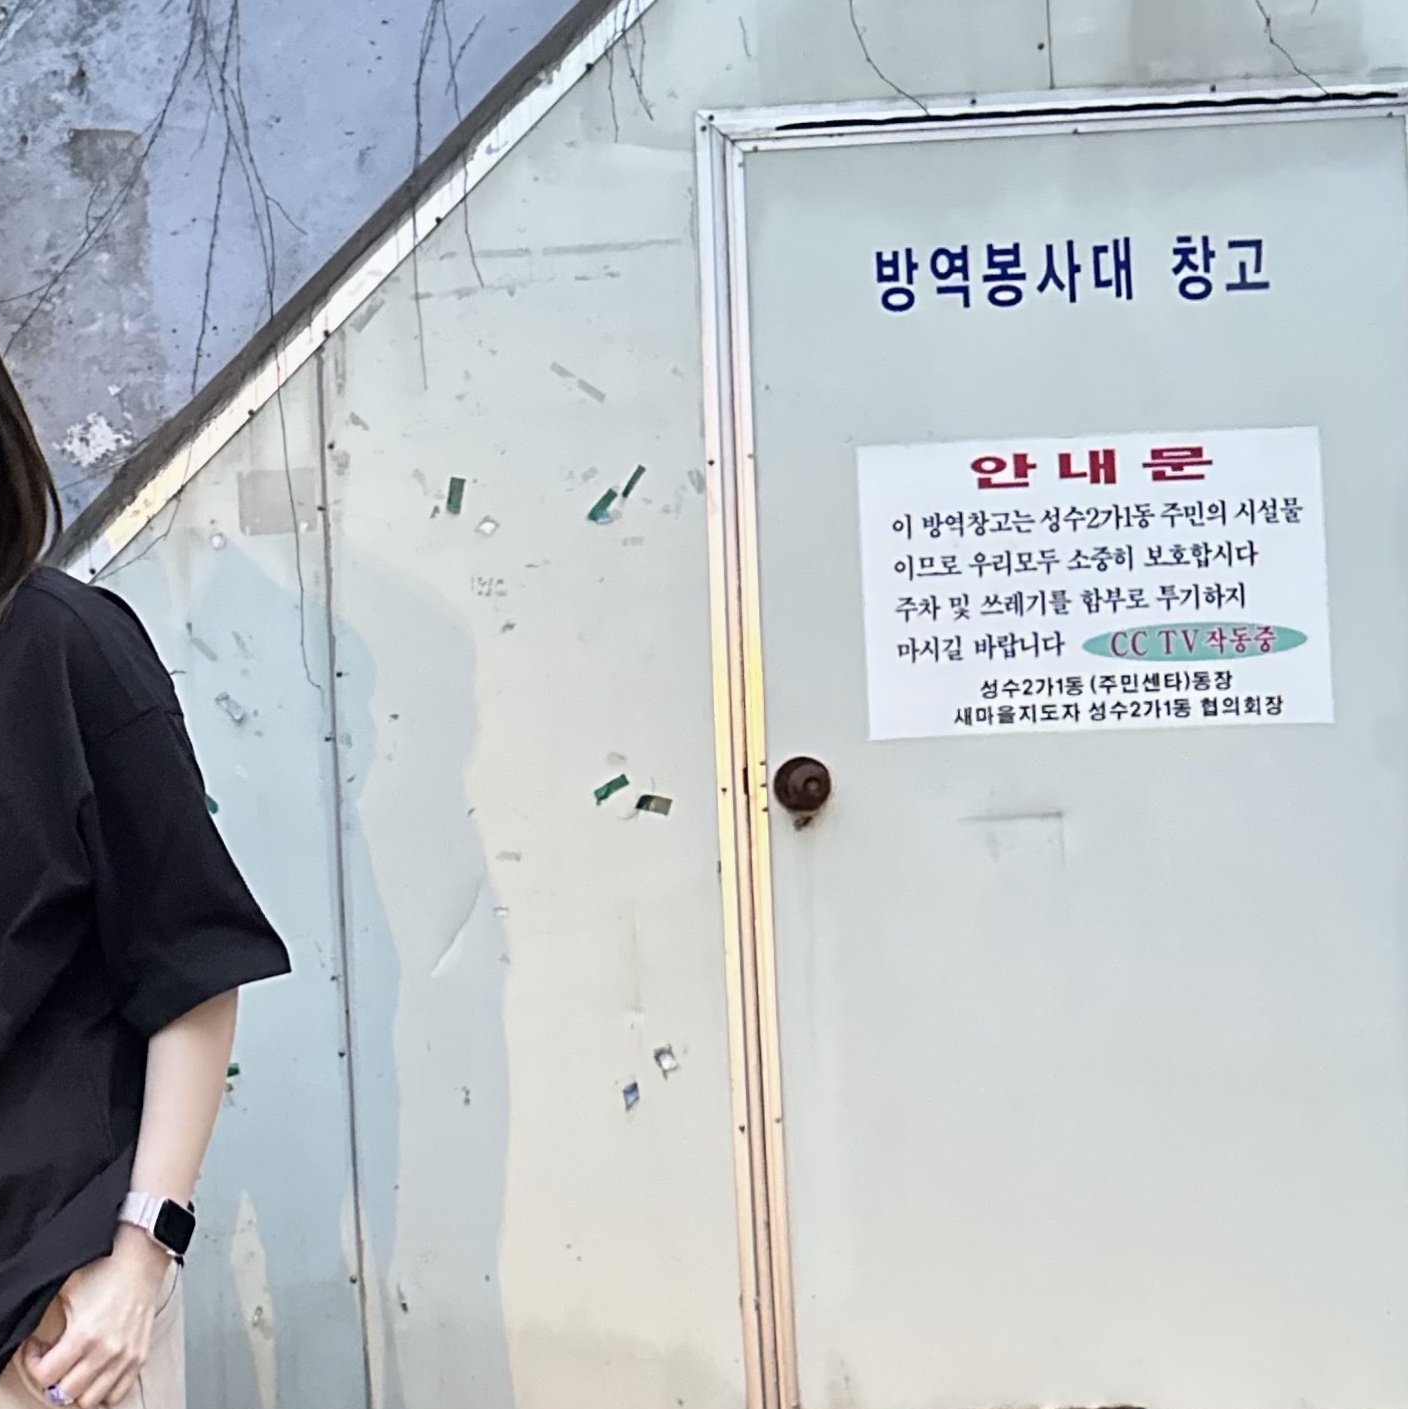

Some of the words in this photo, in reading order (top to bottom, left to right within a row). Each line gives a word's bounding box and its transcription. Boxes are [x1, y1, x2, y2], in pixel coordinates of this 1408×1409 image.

[875, 236, 1133, 313] 방역봉사대
[1171, 235, 1270, 301] 창고
[892, 513, 912, 540] 이
[922, 509, 1035, 539] 방역창고는
[1041, 502, 1156, 533] 성수2가1동
[1160, 499, 1227, 528] 주민의
[1235, 497, 1303, 525] 시설물
[893, 554, 963, 582] 이므로
[969, 548, 1060, 578] 우리모두
[1068, 544, 1134, 573] 소중히
[1144, 539, 1259, 569] 보호합시다
[895, 594, 941, 623] 주차
[948, 593, 970, 621] 및
[980, 589, 1072, 617] 쓰레기를
[1081, 587, 1150, 615] 함부로
[1156, 581, 1245, 611] 투기하지
[897, 634, 963, 664] 마시길
[974, 630, 1065, 660] 바랍니다
[980, 676, 1084, 700] 성수2가1동
[954, 702, 1081, 726] 새마을지도자
[1088, 698, 1192, 722] 성수2가1동
[1200, 694, 1284, 717] 협의회장
